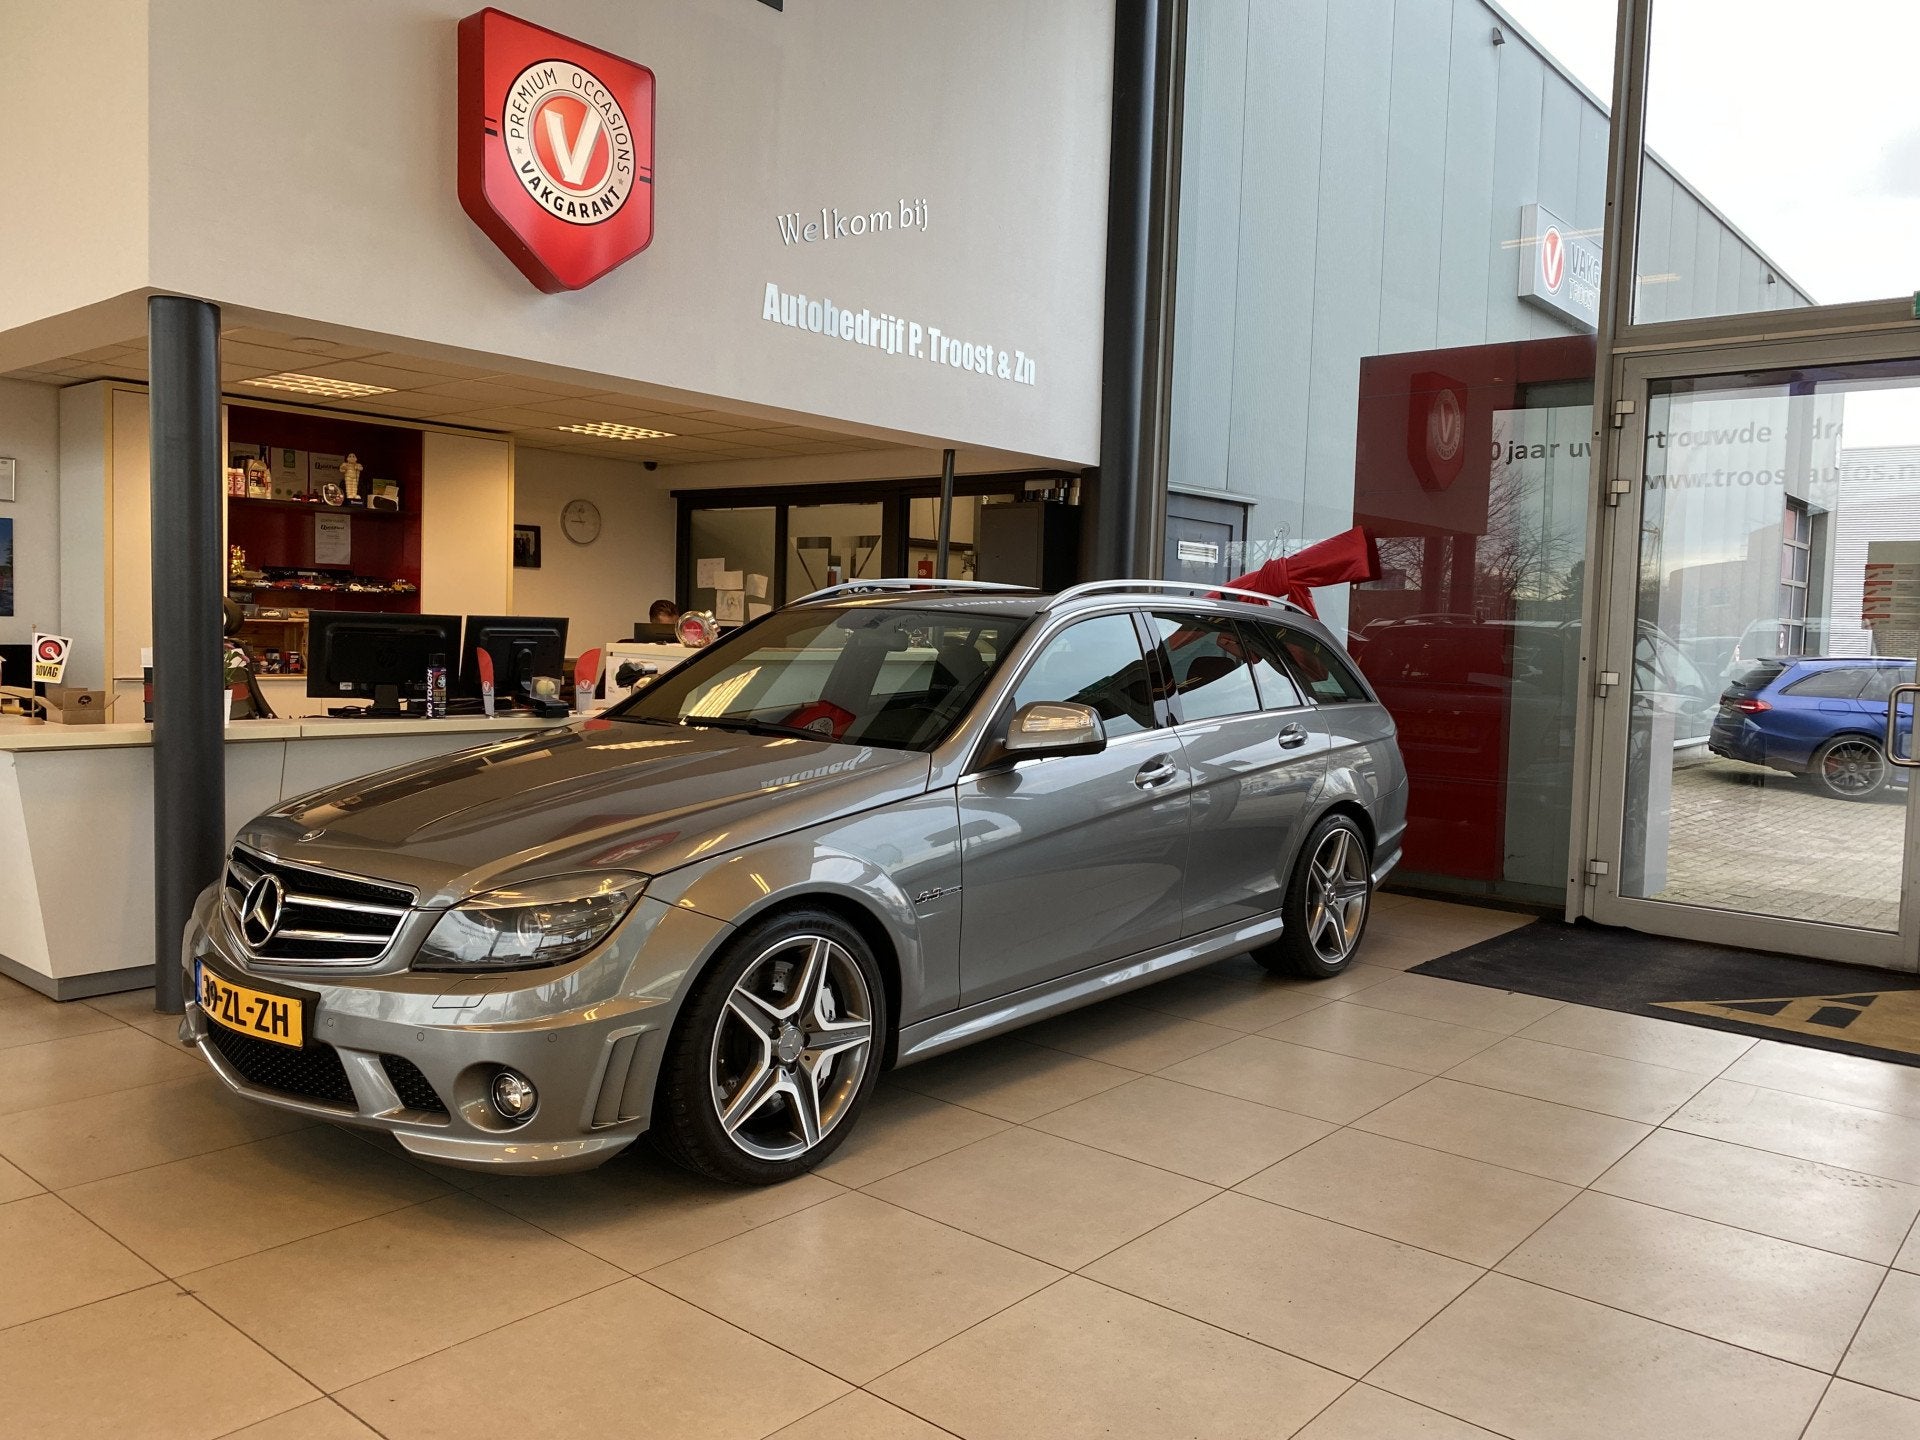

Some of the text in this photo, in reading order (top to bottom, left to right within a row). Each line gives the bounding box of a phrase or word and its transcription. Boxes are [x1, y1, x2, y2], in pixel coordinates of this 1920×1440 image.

[510, 67, 631, 176] PREMIUM OCCASIONS
[543, 104, 604, 186] V
[519, 159, 623, 219] VAKGARANT
[776, 197, 929, 247] Welkom bij
[762, 281, 1037, 386] Autobedrijf P. Troost & Zn
[1506, 440, 1560, 465] jaar
[426, 704, 433, 718] NO
